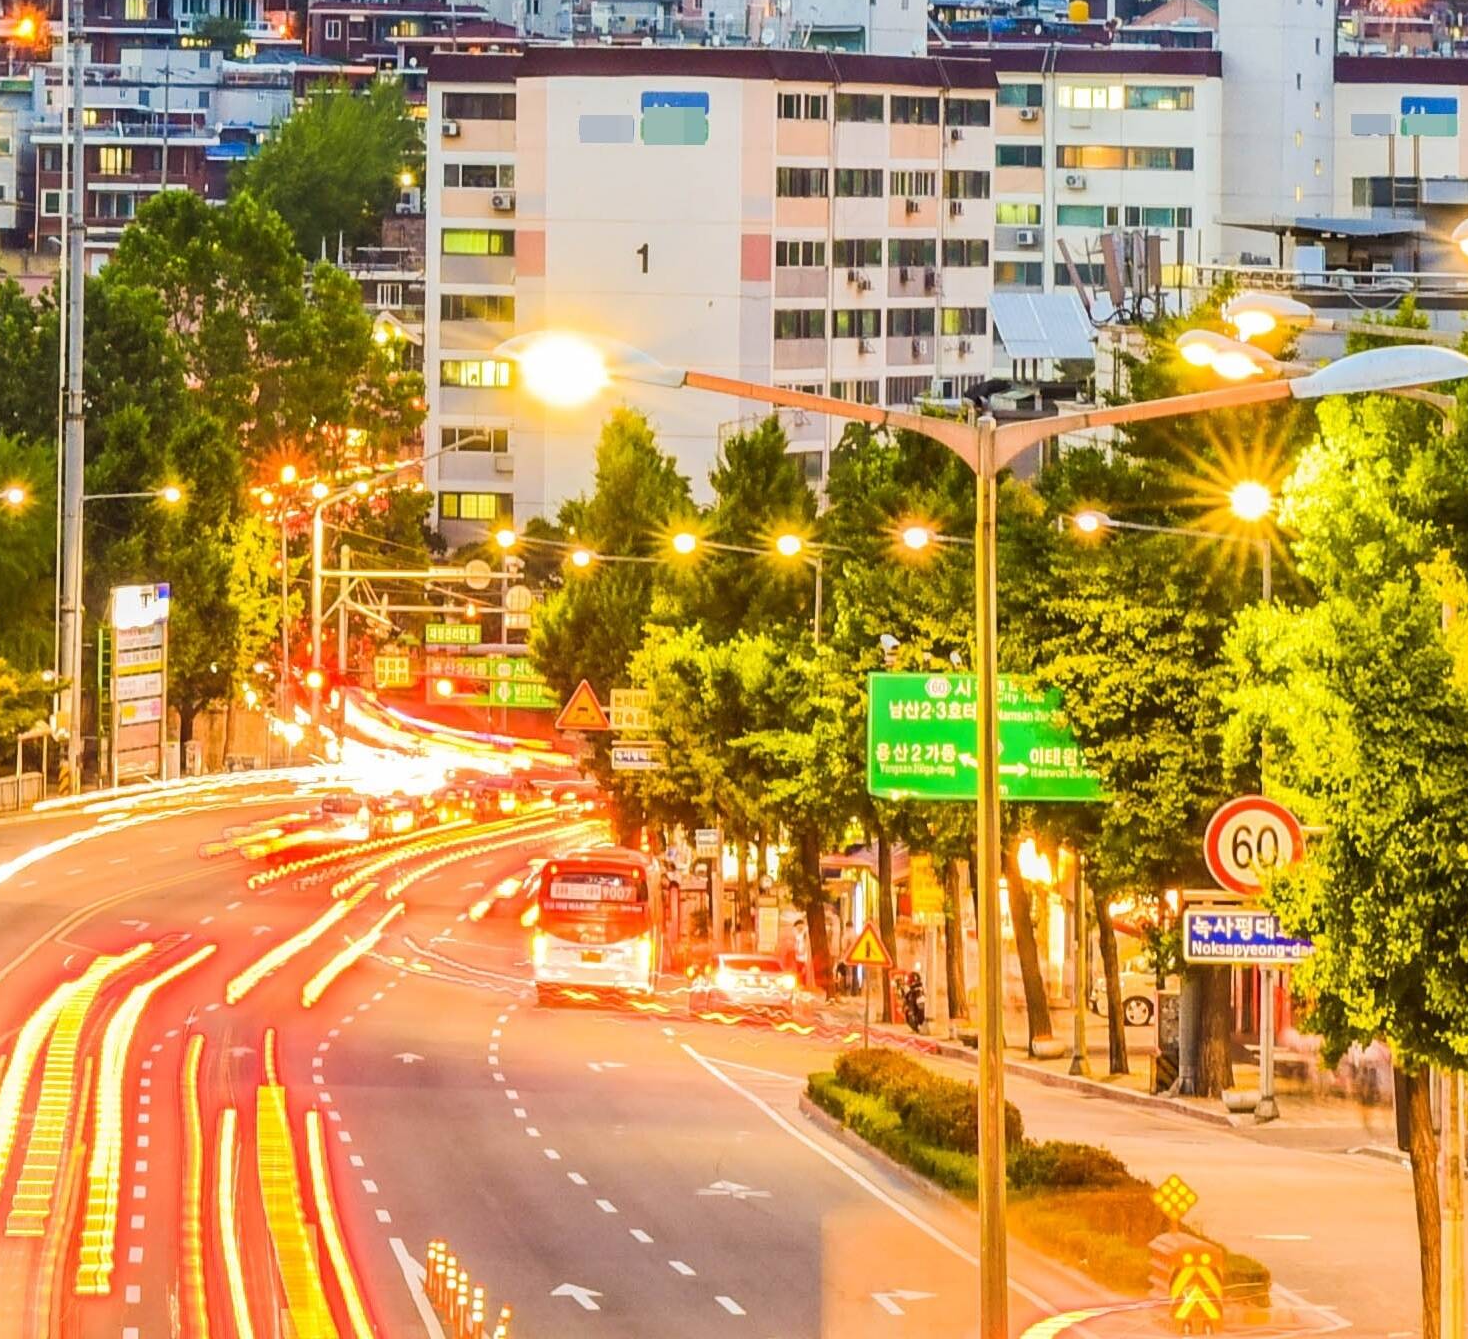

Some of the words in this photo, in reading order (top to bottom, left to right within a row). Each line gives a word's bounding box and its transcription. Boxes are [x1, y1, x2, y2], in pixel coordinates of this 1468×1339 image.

[636, 243, 649, 274] 1
[889, 700, 977, 721] 남산2·3호터
[876, 743, 957, 763] 용산2가동
[1231, 825, 1279, 869] 60
